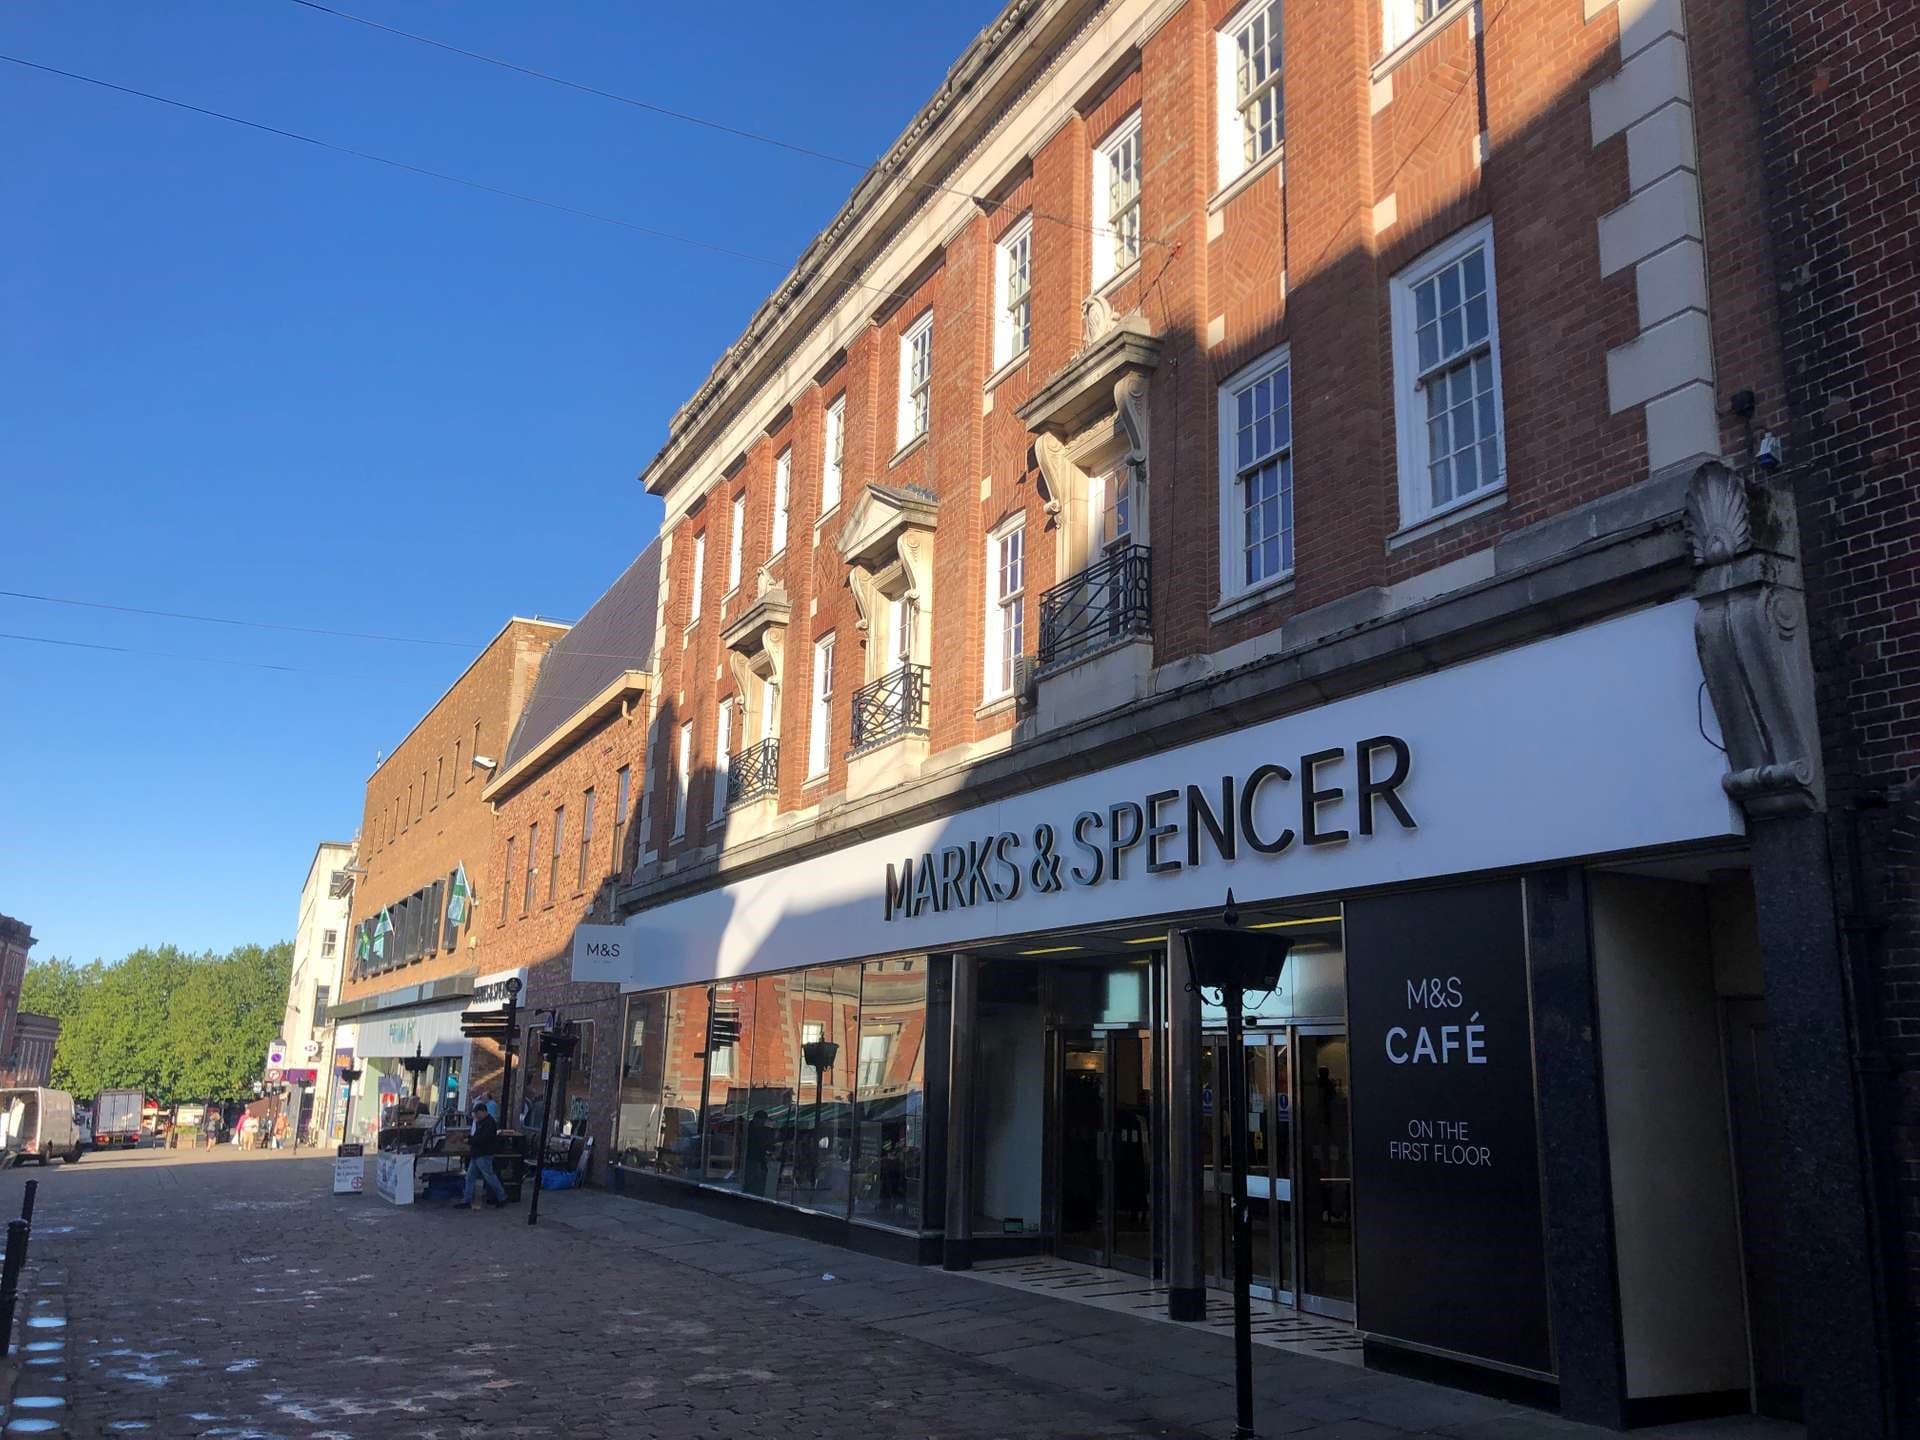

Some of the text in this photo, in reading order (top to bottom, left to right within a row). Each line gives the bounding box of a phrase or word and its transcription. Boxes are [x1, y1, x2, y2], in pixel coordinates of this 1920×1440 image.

[586, 943, 620, 957] M&S
[1407, 976, 1463, 1009] M&S
[1385, 1011, 1488, 1064] CAFÉ
[1408, 1119, 1470, 1141] ON THE
[1390, 1141, 1492, 1167] FIRST FLOOR
